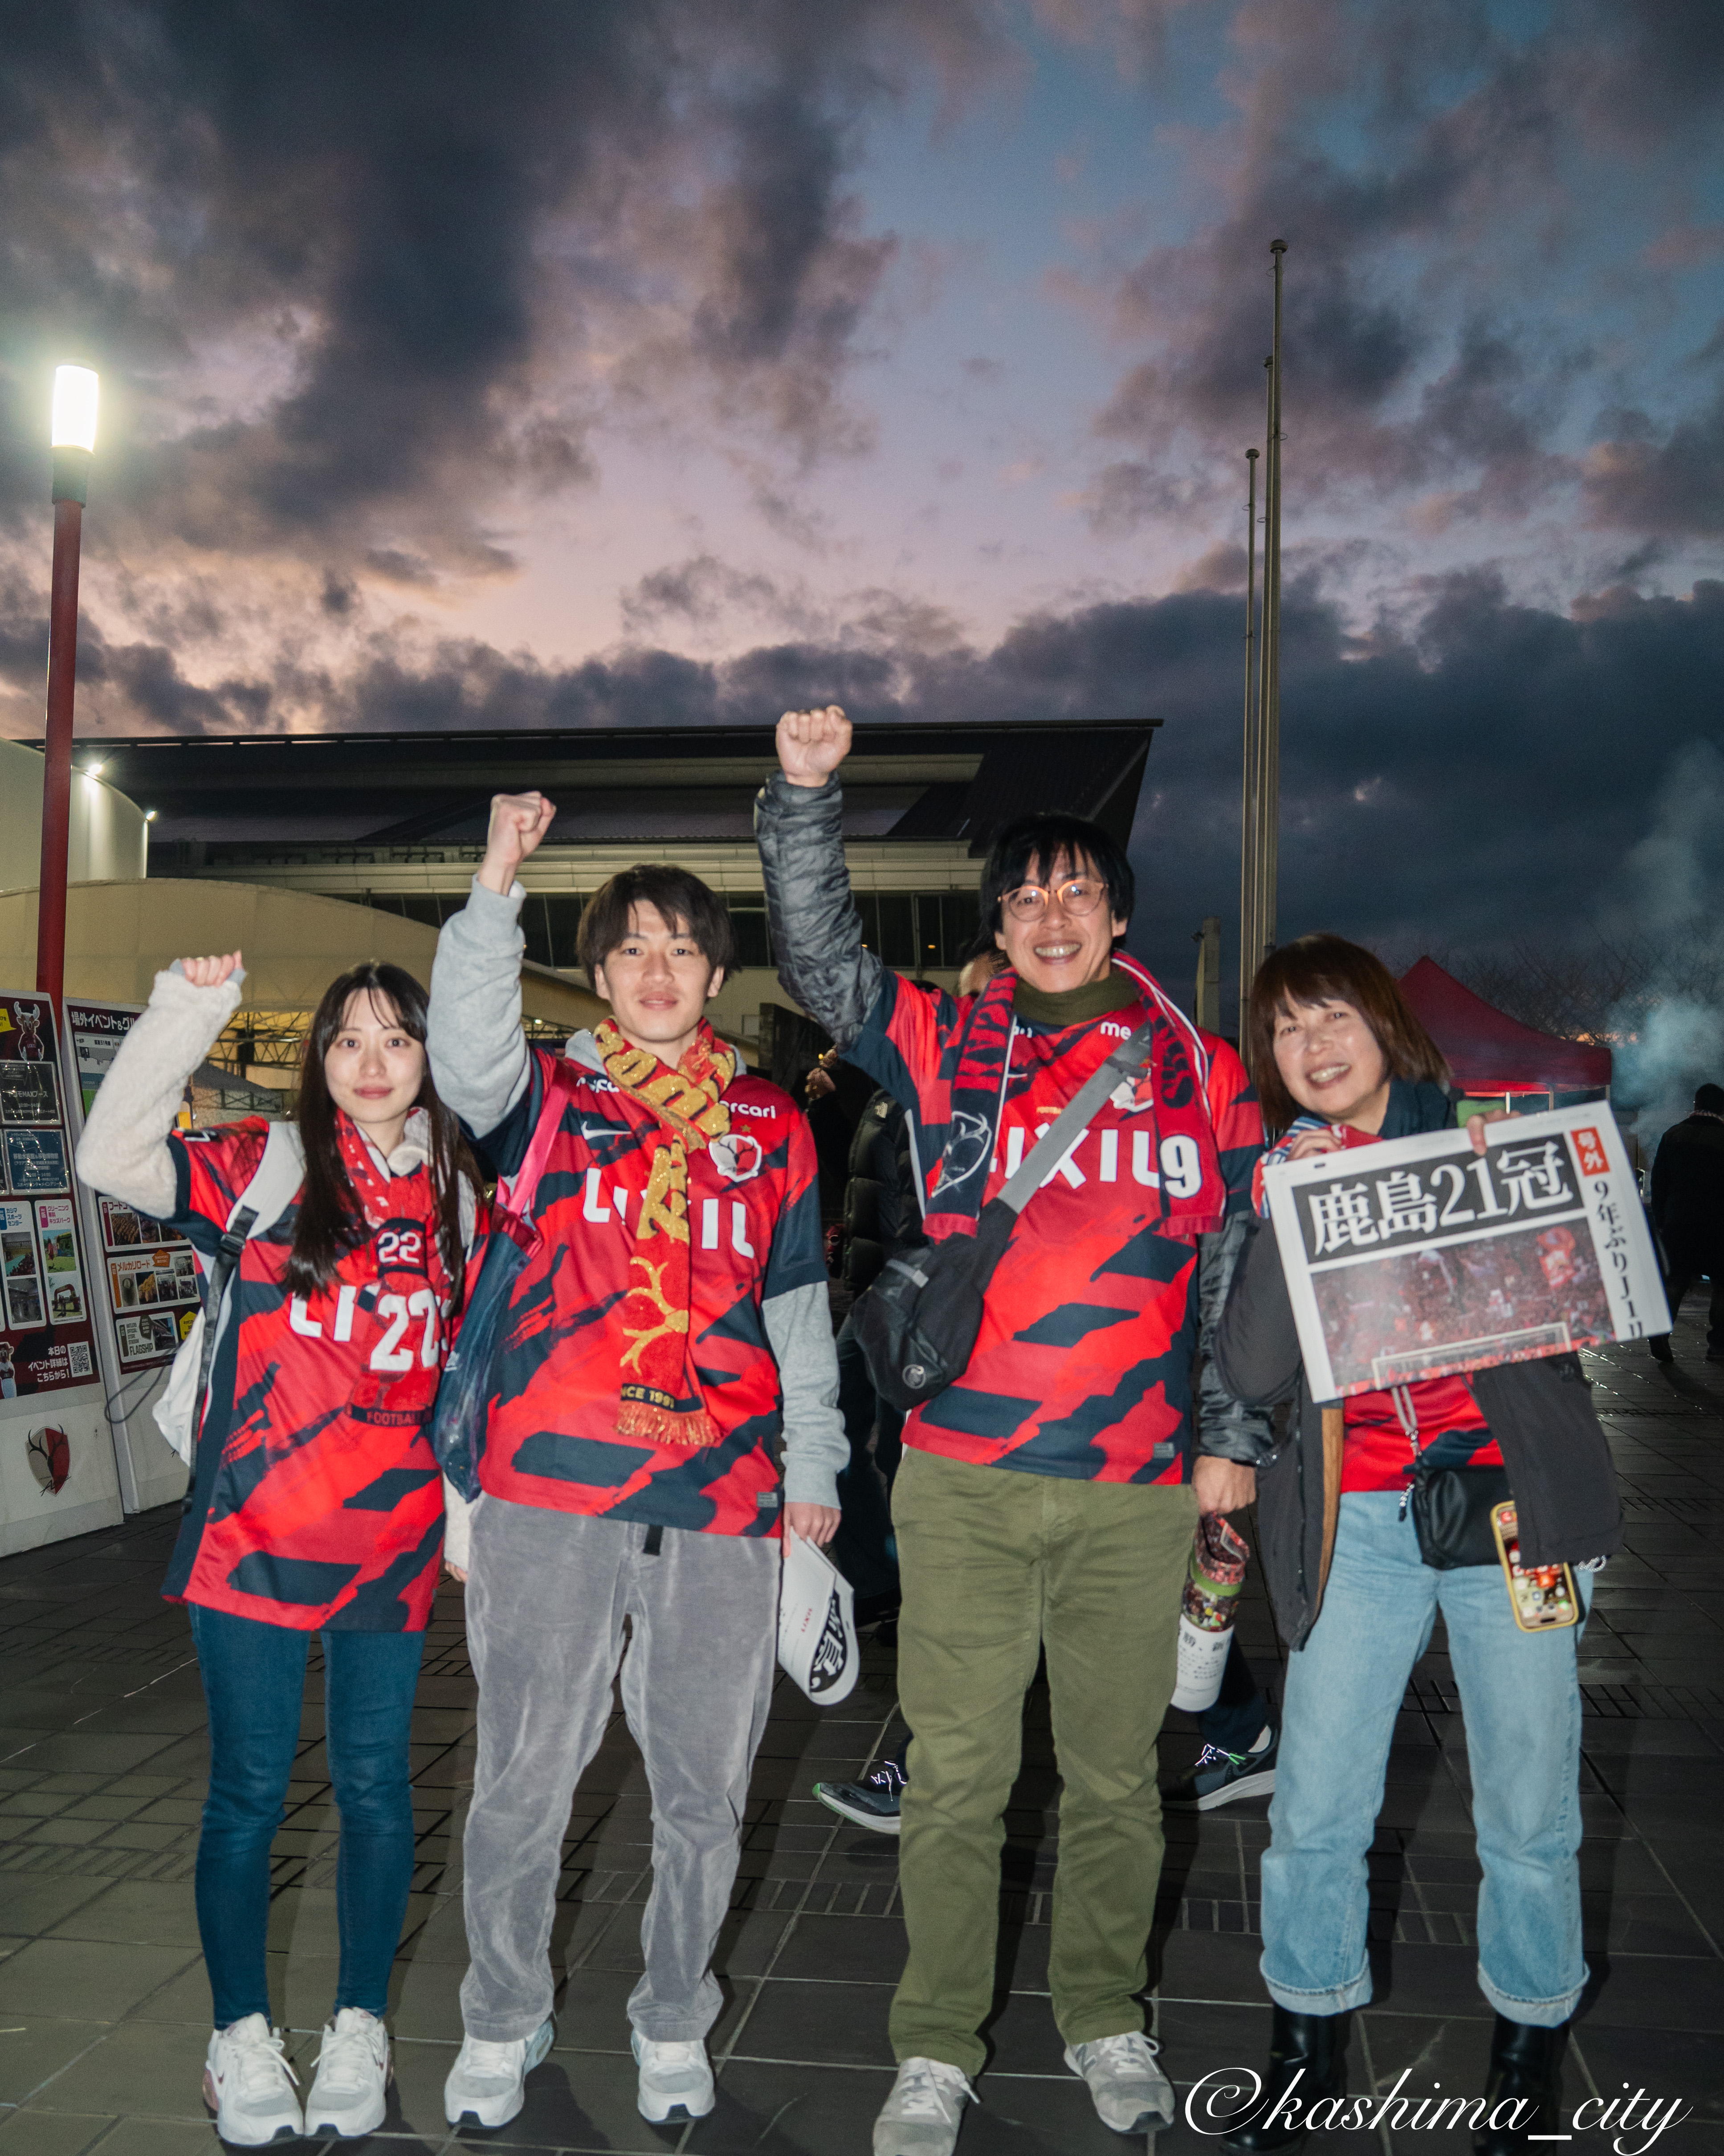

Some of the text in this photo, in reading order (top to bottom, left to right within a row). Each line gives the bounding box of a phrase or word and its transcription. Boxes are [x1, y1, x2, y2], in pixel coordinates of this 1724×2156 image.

[989, 1122, 1160, 1190] IXIL
[1577, 1131, 1603, 1171] 号外
[1160, 1134, 1203, 1199] 9
[1308, 1139, 1573, 1255] 鹿島21冠
[377, 1231, 421, 1264] 22
[117, 1259, 151, 1271] メルカリロード
[48, 1345, 66, 1356] 本日の
[129, 1343, 154, 1356] FLAGSHIP
[28, 1357, 69, 1372] イベント詳細は
[37, 1368, 70, 1383] こちらから!
